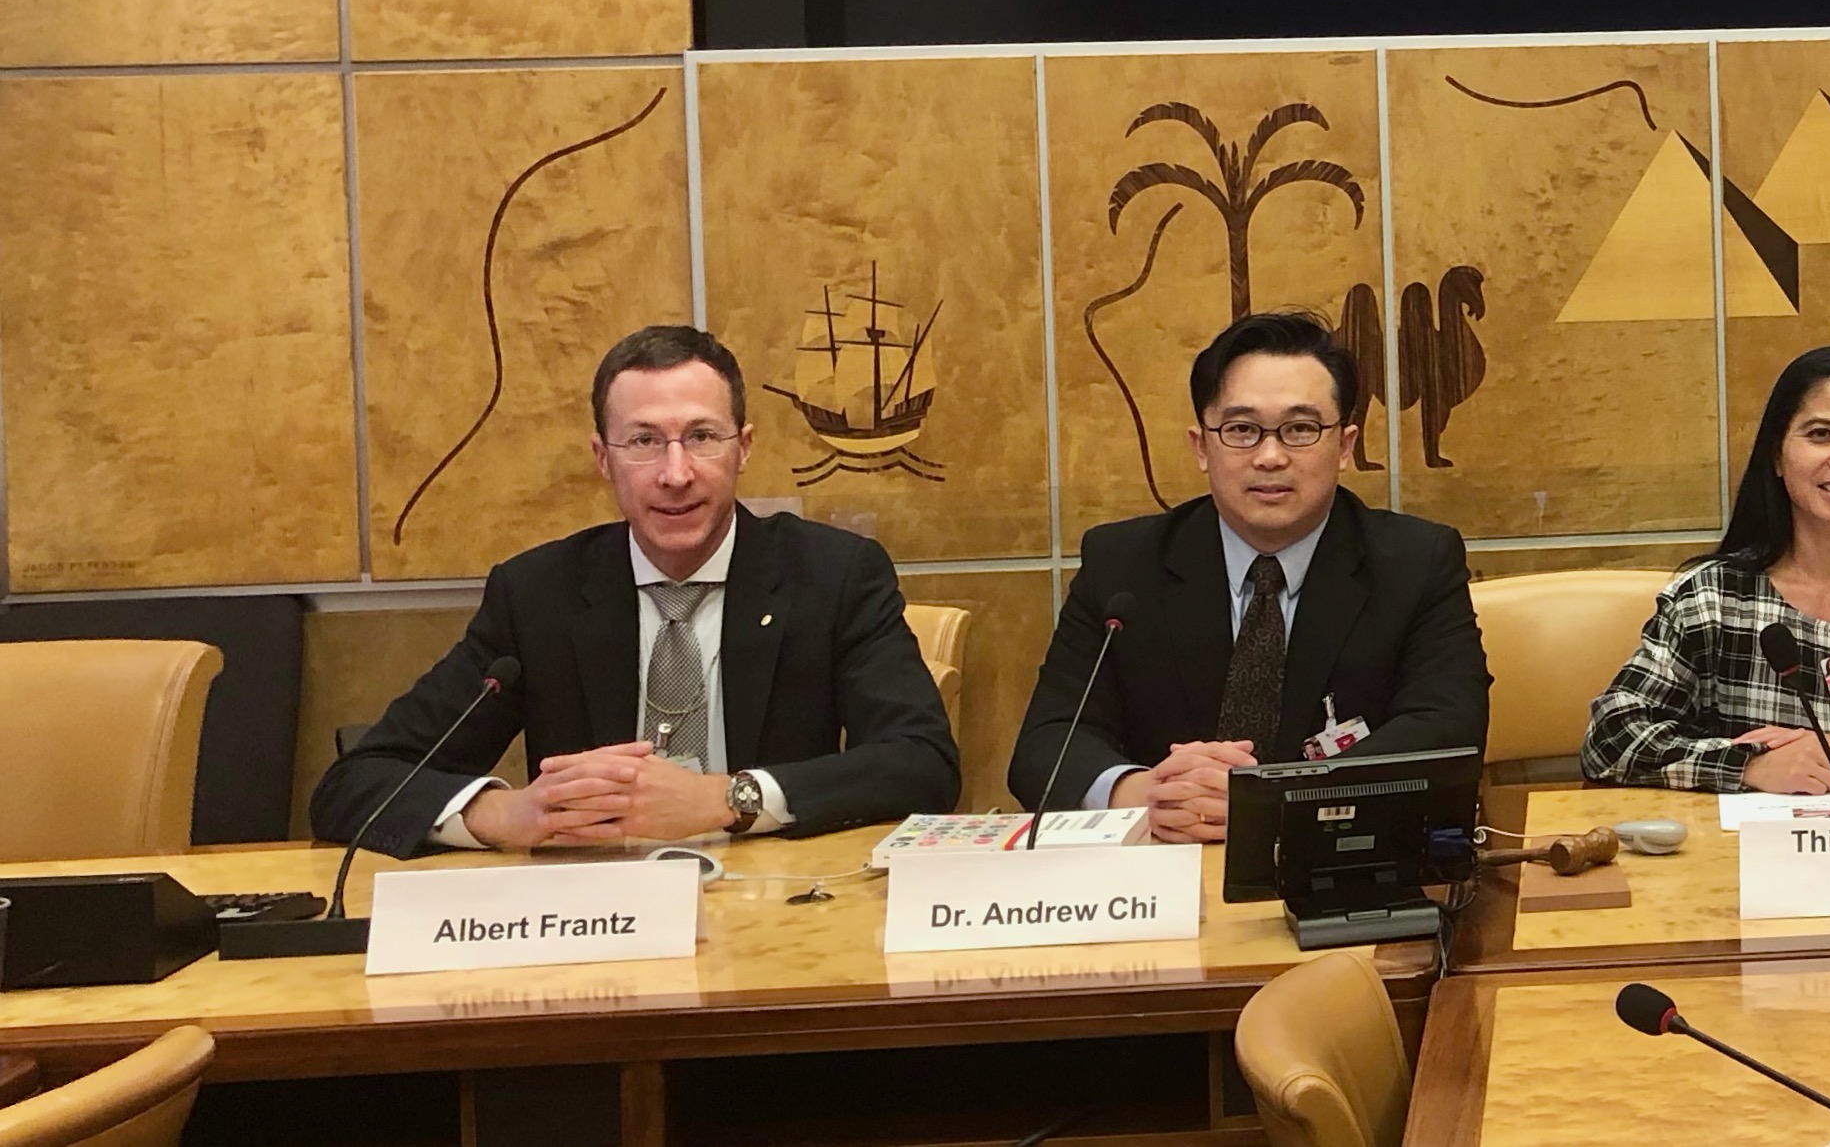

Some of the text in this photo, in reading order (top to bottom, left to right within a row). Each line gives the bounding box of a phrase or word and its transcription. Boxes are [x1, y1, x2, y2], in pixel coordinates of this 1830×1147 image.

[932, 896, 1156, 927] Dr. Andrew Chi
[434, 913, 635, 943] Albert Frantz
